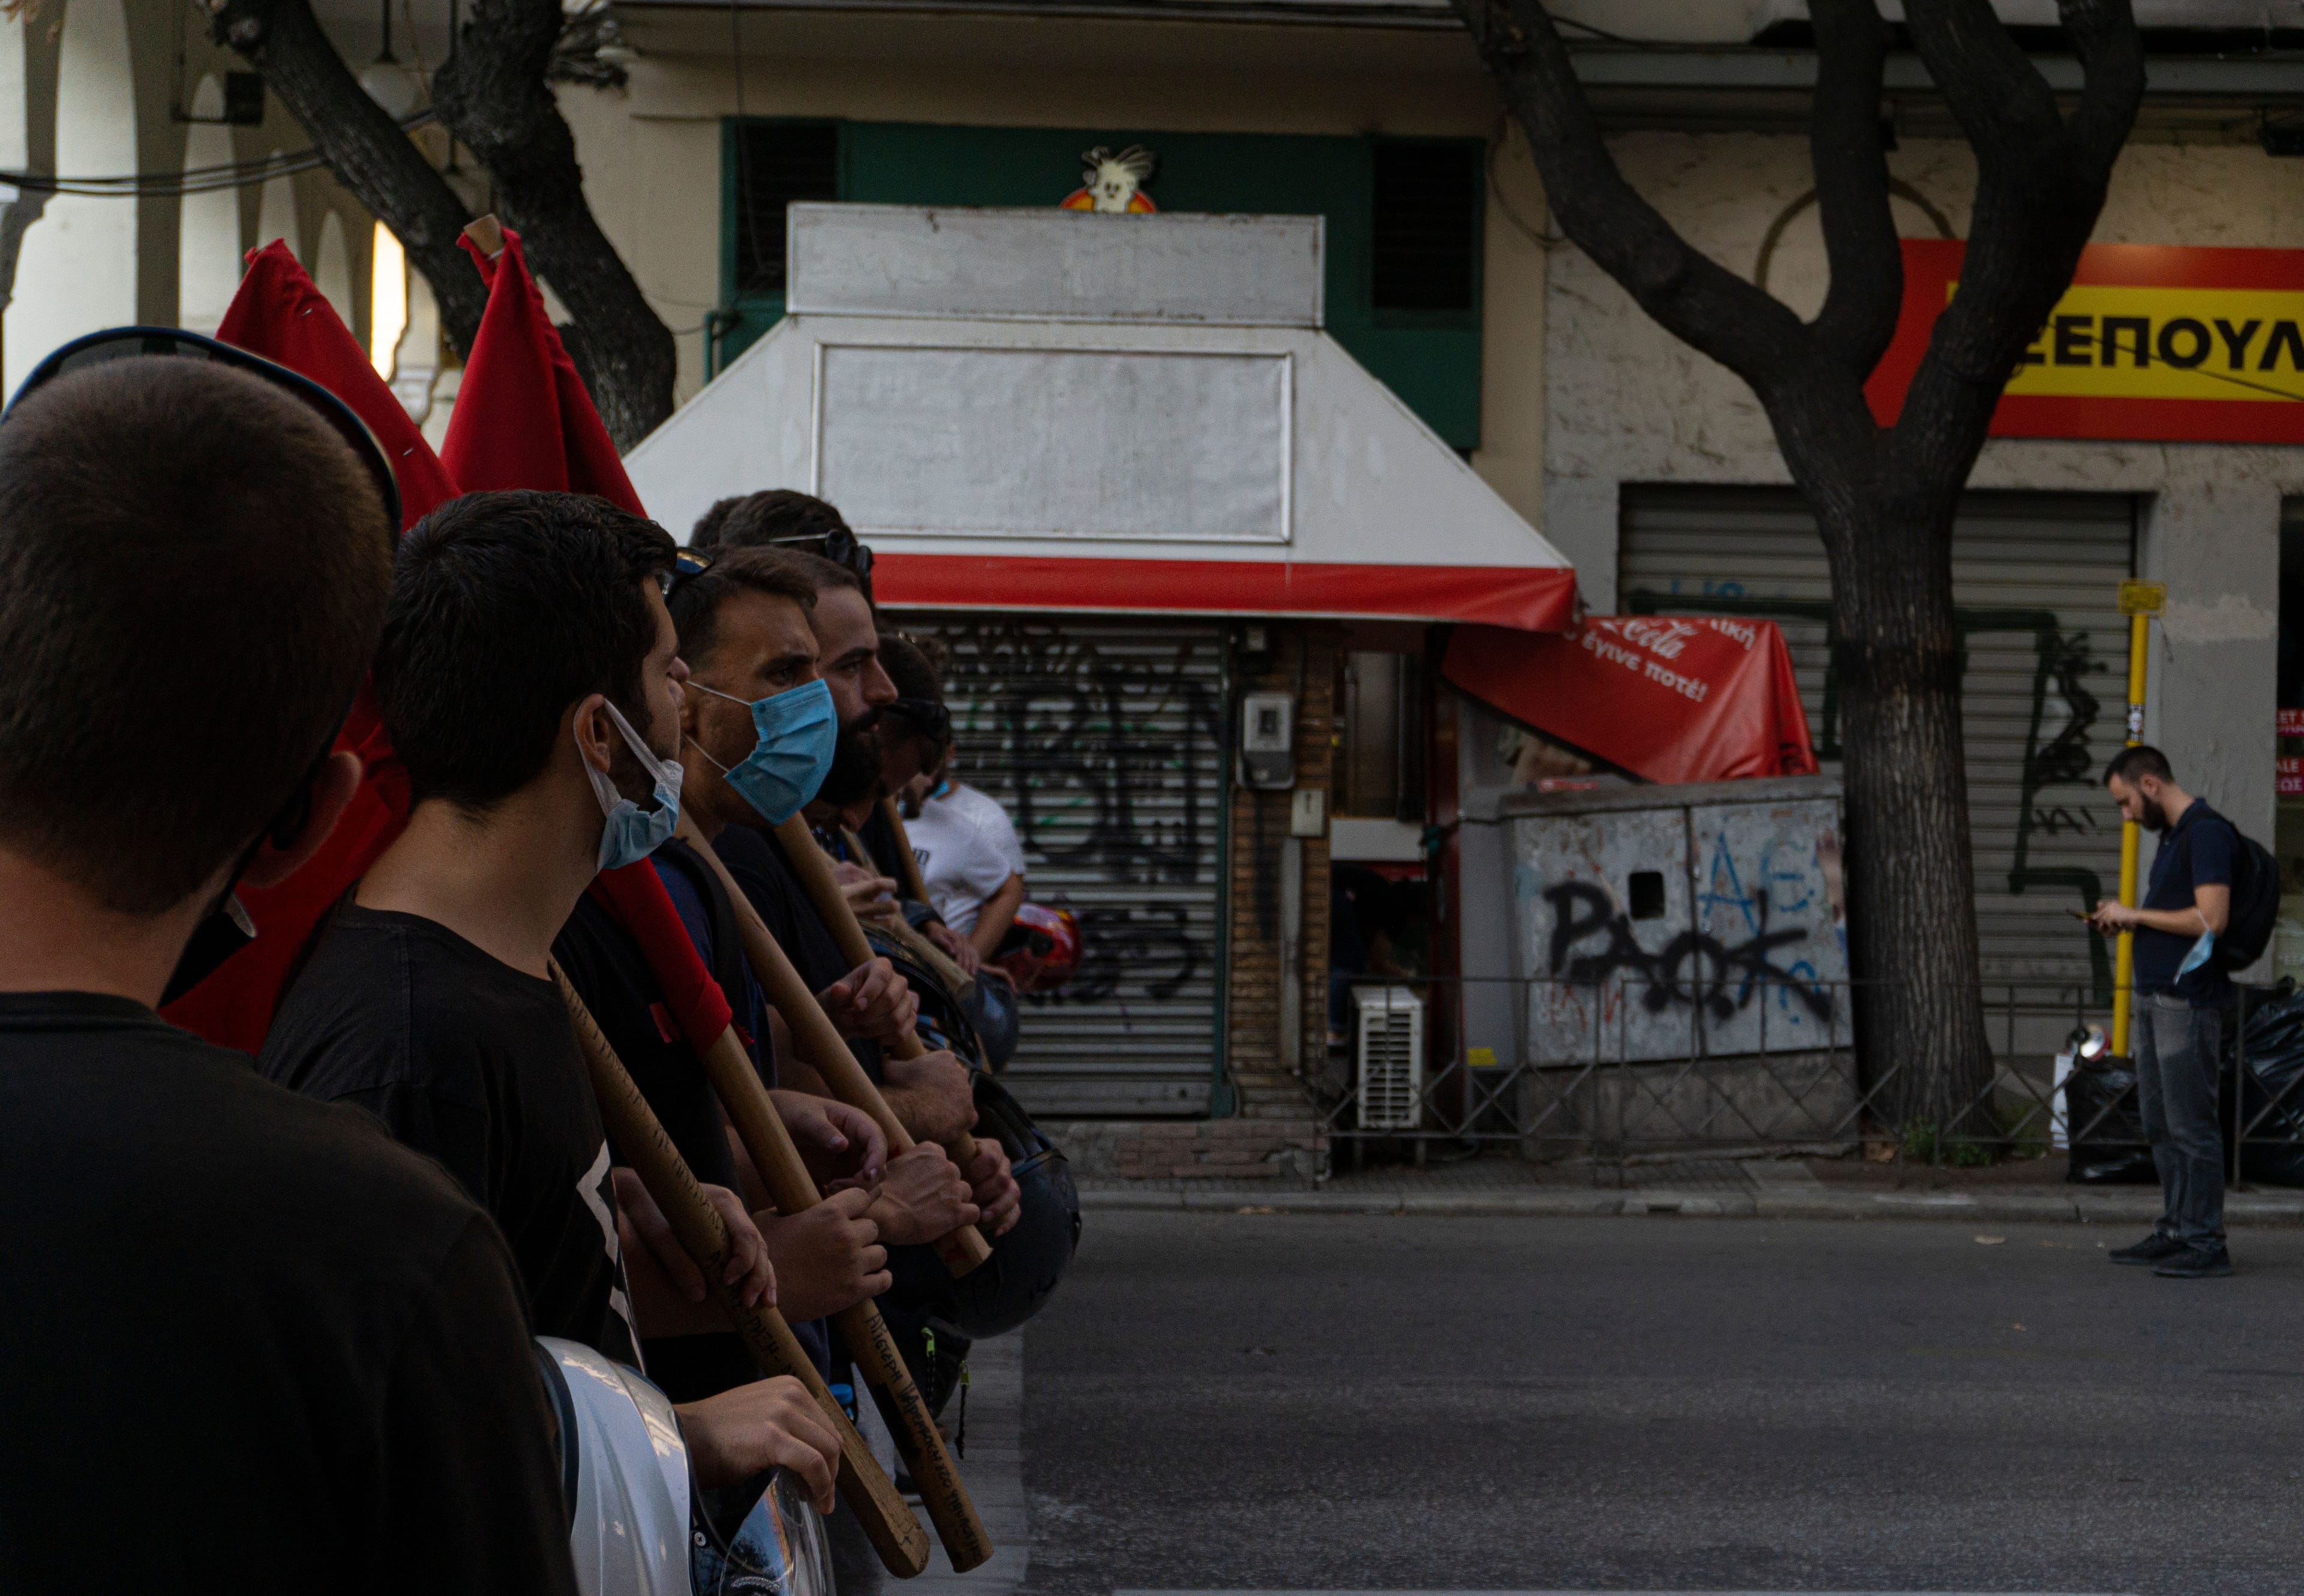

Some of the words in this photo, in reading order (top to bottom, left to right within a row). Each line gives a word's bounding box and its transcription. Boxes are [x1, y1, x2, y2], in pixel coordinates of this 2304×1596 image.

[2024, 316, 2304, 372] ΕΠΟΥΛ
[1582, 630, 1642, 671] έγινε
[1644, 659, 1709, 703] ποτέ!
